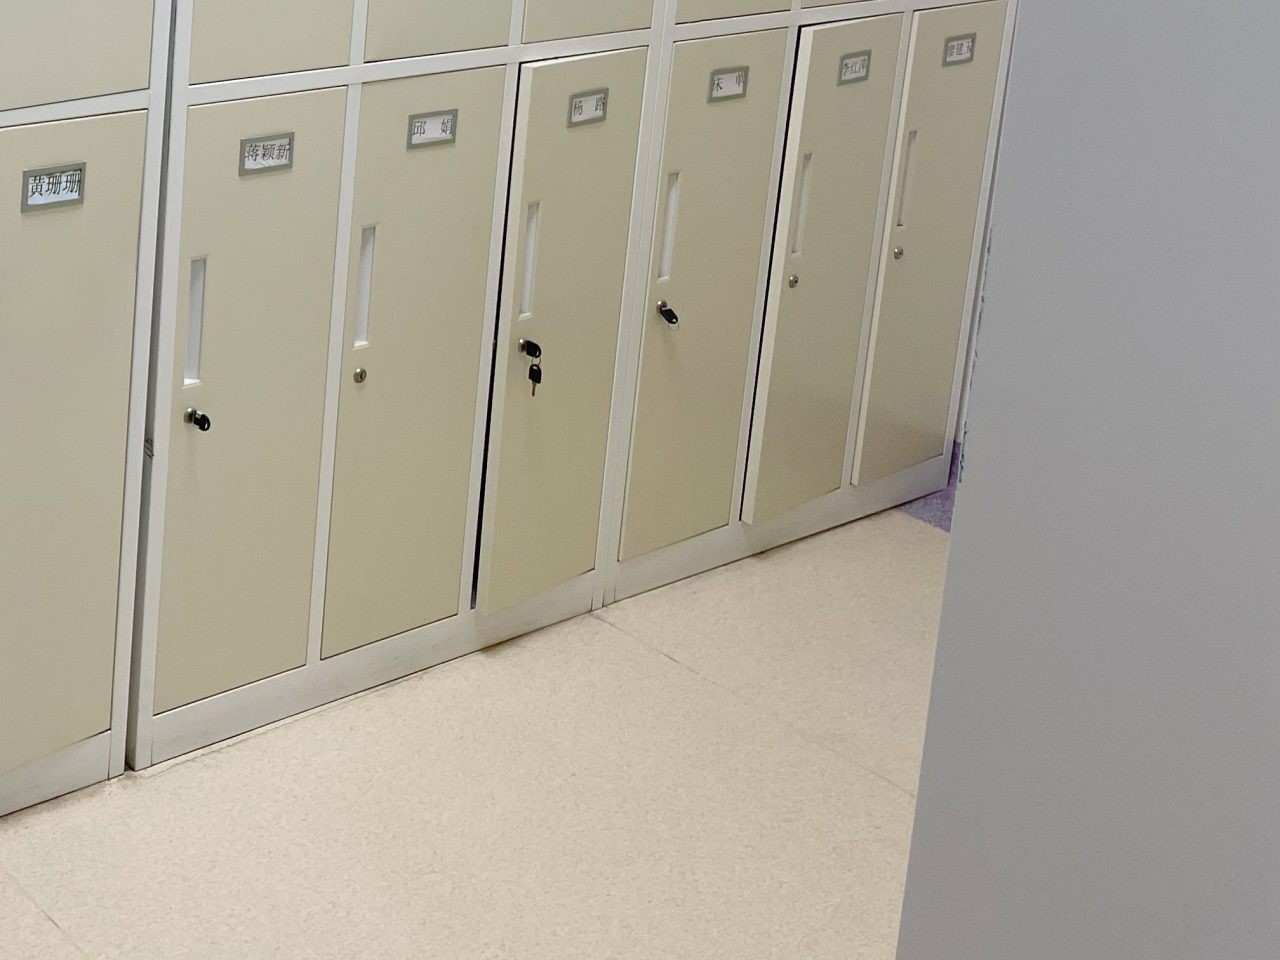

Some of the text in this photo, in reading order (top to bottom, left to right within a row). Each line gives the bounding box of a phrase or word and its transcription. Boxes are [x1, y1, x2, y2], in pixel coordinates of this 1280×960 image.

[245, 143, 290, 161] 蒋颖新
[29, 172, 81, 198] 黄珊珊
